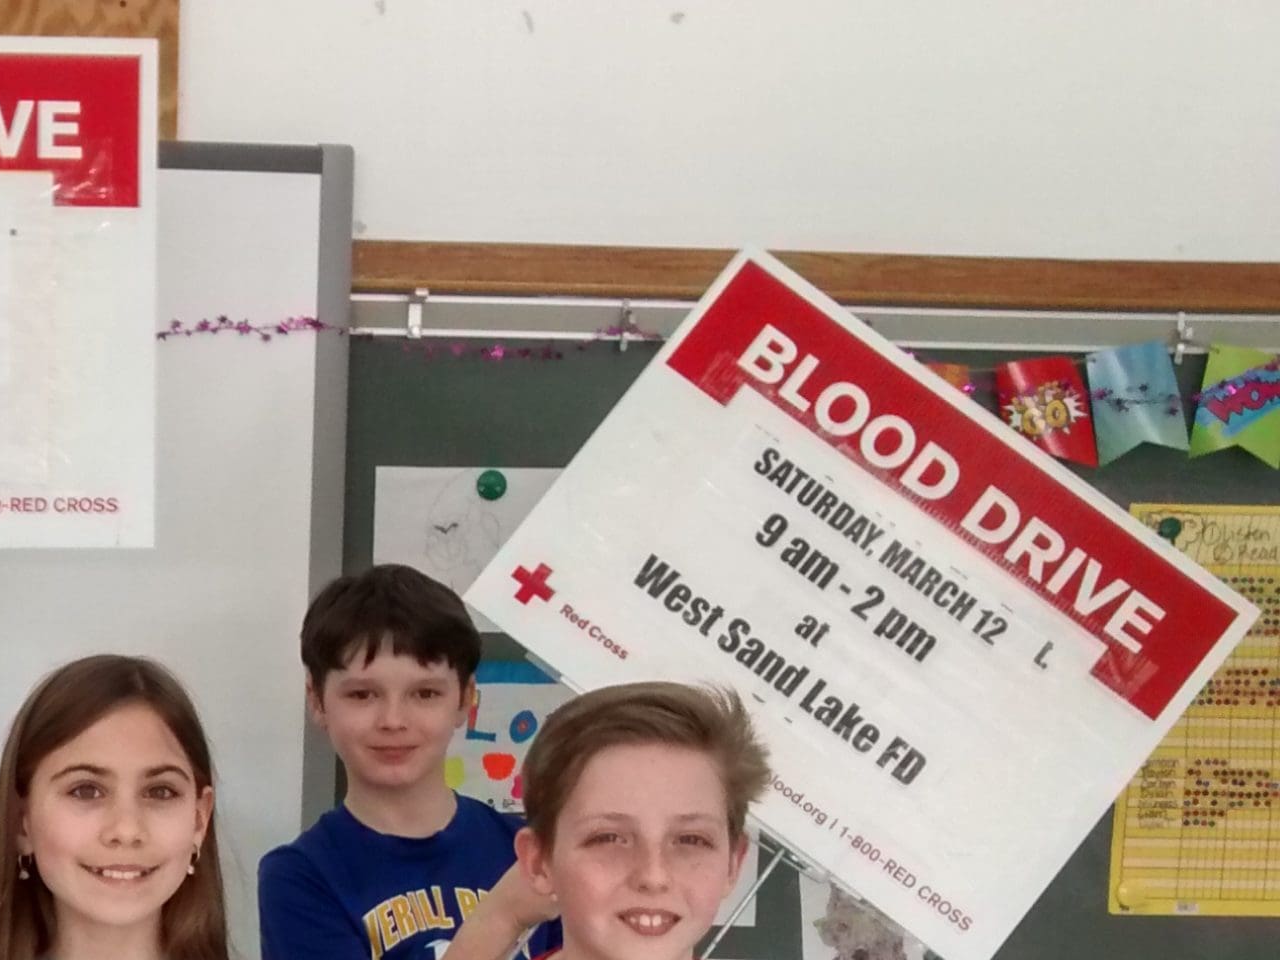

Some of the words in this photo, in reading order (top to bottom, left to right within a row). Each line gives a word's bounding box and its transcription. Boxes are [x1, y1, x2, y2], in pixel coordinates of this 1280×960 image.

[53, 496, 119, 514] CROSS
[737, 323, 960, 500] BLOOD
[961, 485, 1166, 655] DRIVE
[754, 447, 885, 556] SATURDAY,
[878, 539, 978, 622] MARCH
[972, 608, 1009, 646] 12
[560, 603, 591, 630] Red
[588, 624, 629, 660] Cross
[755, 513, 788, 548] 9
[780, 536, 840, 591] am
[850, 584, 885, 621] 2
[873, 606, 938, 662] pm
[794, 613, 831, 648] at
[633, 553, 725, 637] West
[717, 617, 810, 698] Sand
[799, 678, 880, 753] Lake
[876, 736, 927, 787] FD
[769, 774, 827, 825] lood.org
[839, 826, 917, 890] 1-800-RED
[918, 885, 974, 932] CROSS
